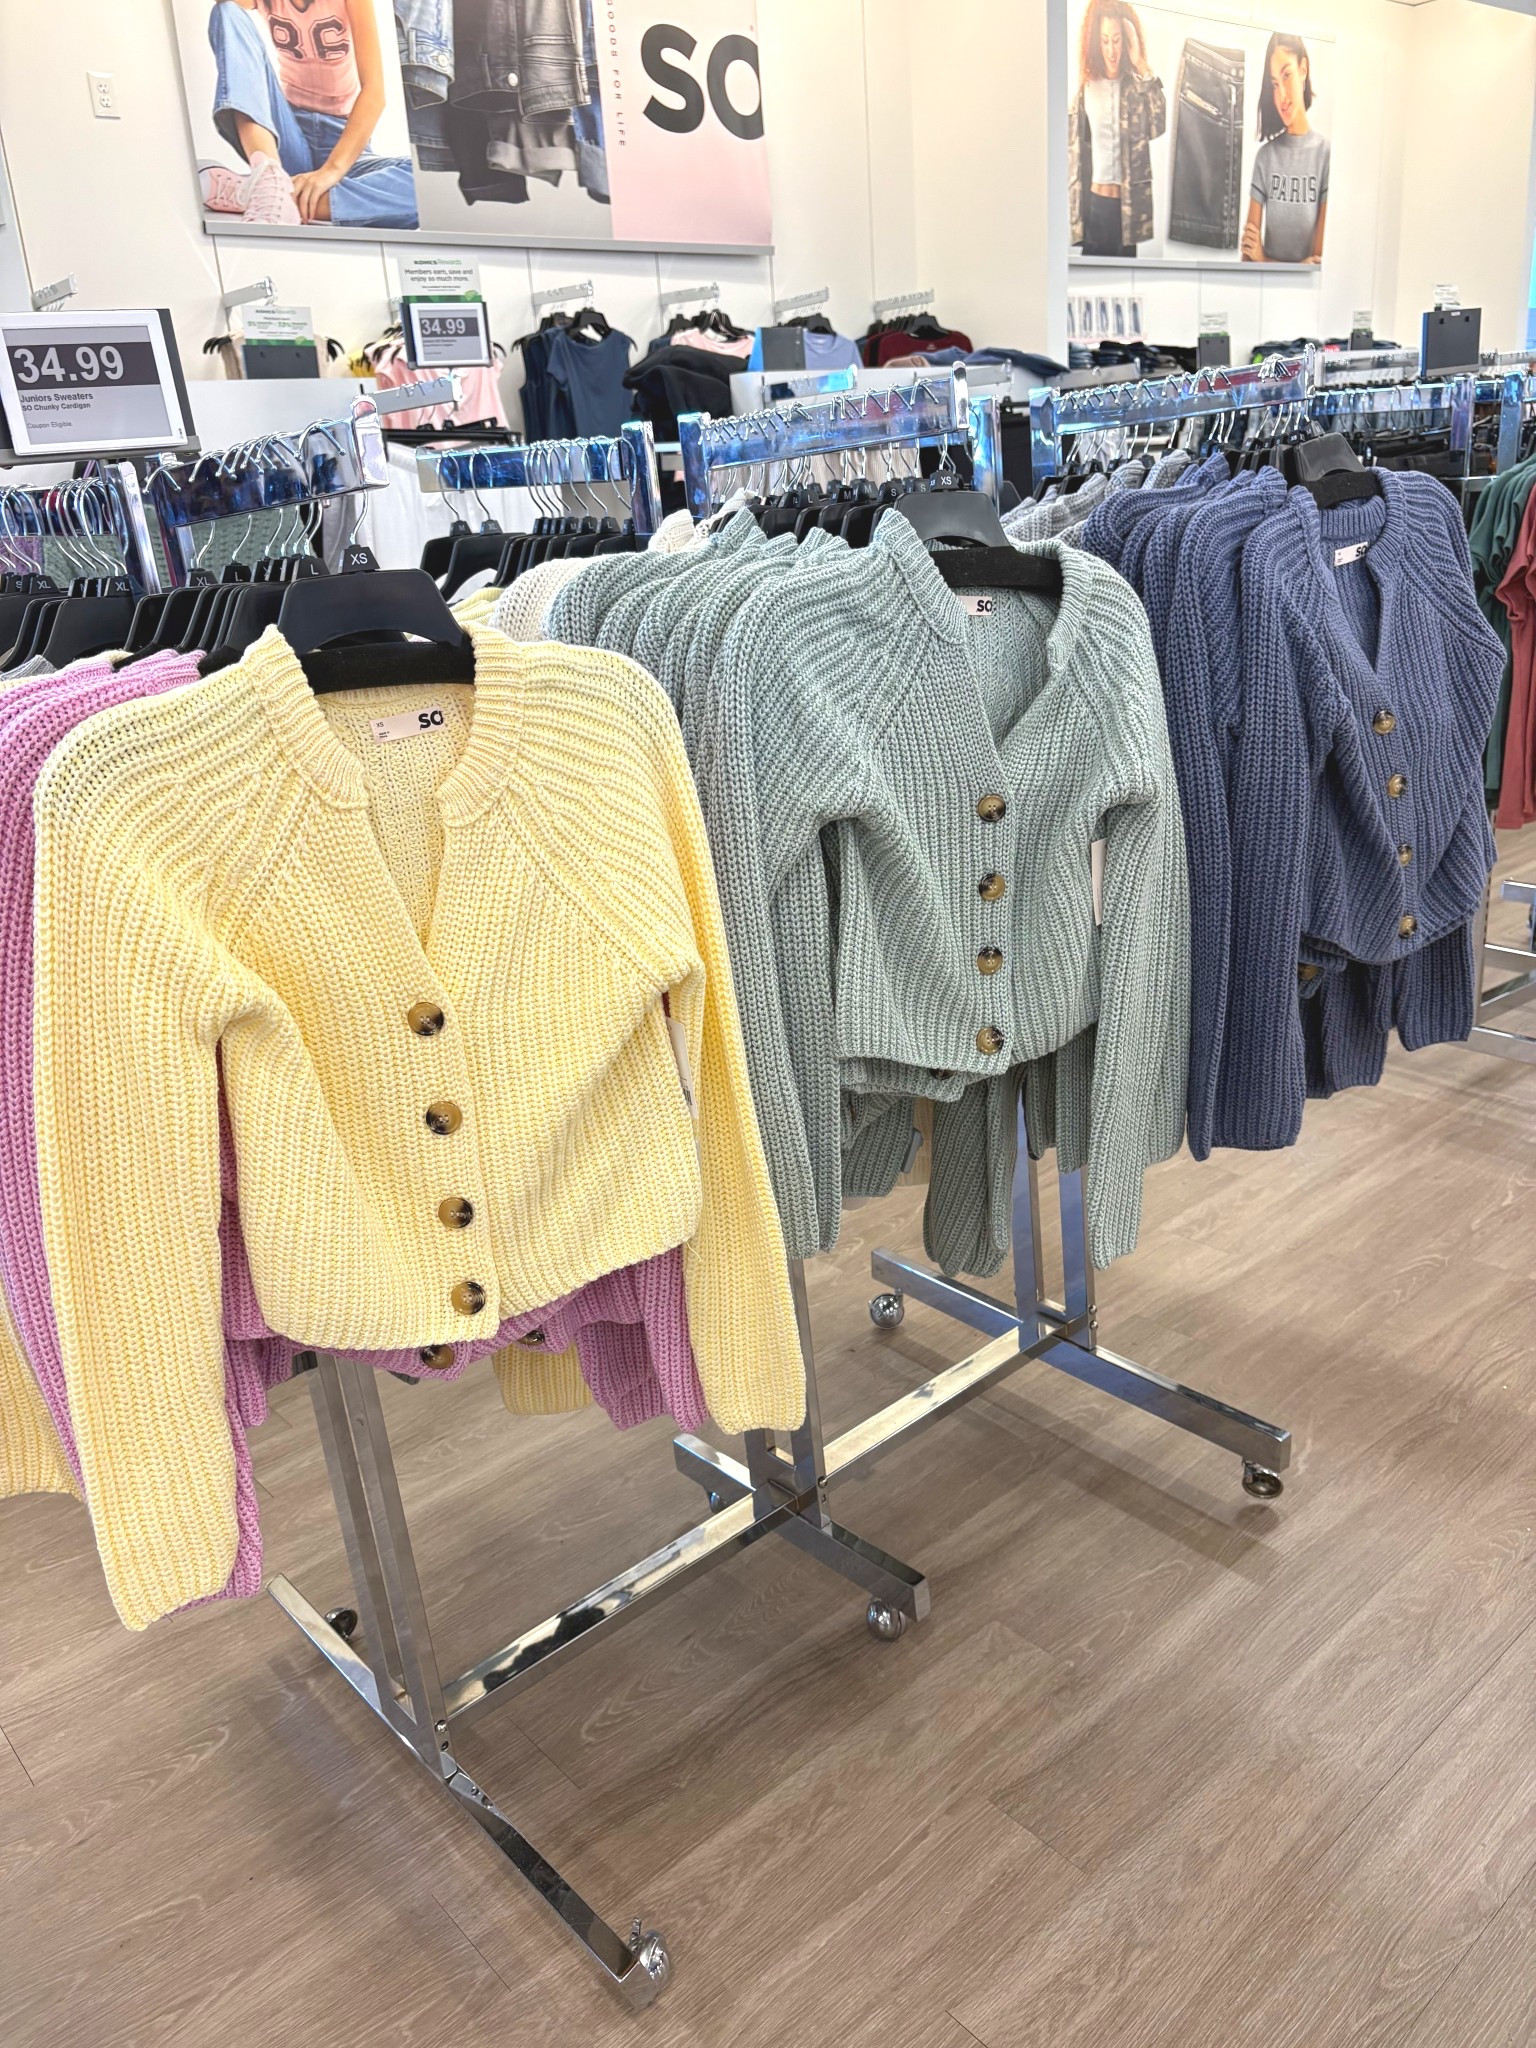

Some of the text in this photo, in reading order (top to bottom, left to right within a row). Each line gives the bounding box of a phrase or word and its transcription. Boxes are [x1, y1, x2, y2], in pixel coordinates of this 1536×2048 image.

[613, 69, 622, 100] FOR
[641, 23, 765, 140] SO
[616, 111, 626, 146] LIFE
[1269, 174, 1318, 203] PARIS
[421, 319, 466, 335] 34.99
[14, 345, 124, 383] 34.99
[20, 393, 94, 402] Juniors Sweaters
[941, 476, 952, 485] XS
[865, 485, 872, 493] M
[891, 488, 897, 497] S
[921, 484, 927, 492] S
[807, 494, 814, 504] L
[844, 490, 852, 500] M
[488, 523, 498, 531] XL
[588, 521, 595, 529] L
[607, 521, 613, 529] L
[1355, 545, 1367, 557] SO
[350, 553, 368, 565] XS
[310, 564, 319, 575] L
[196, 576, 211, 586] XL
[235, 571, 243, 582] L
[37, 580, 52, 589] XL
[115, 581, 130, 591] XL
[977, 599, 992, 612] SO
[418, 710, 444, 729] SO
